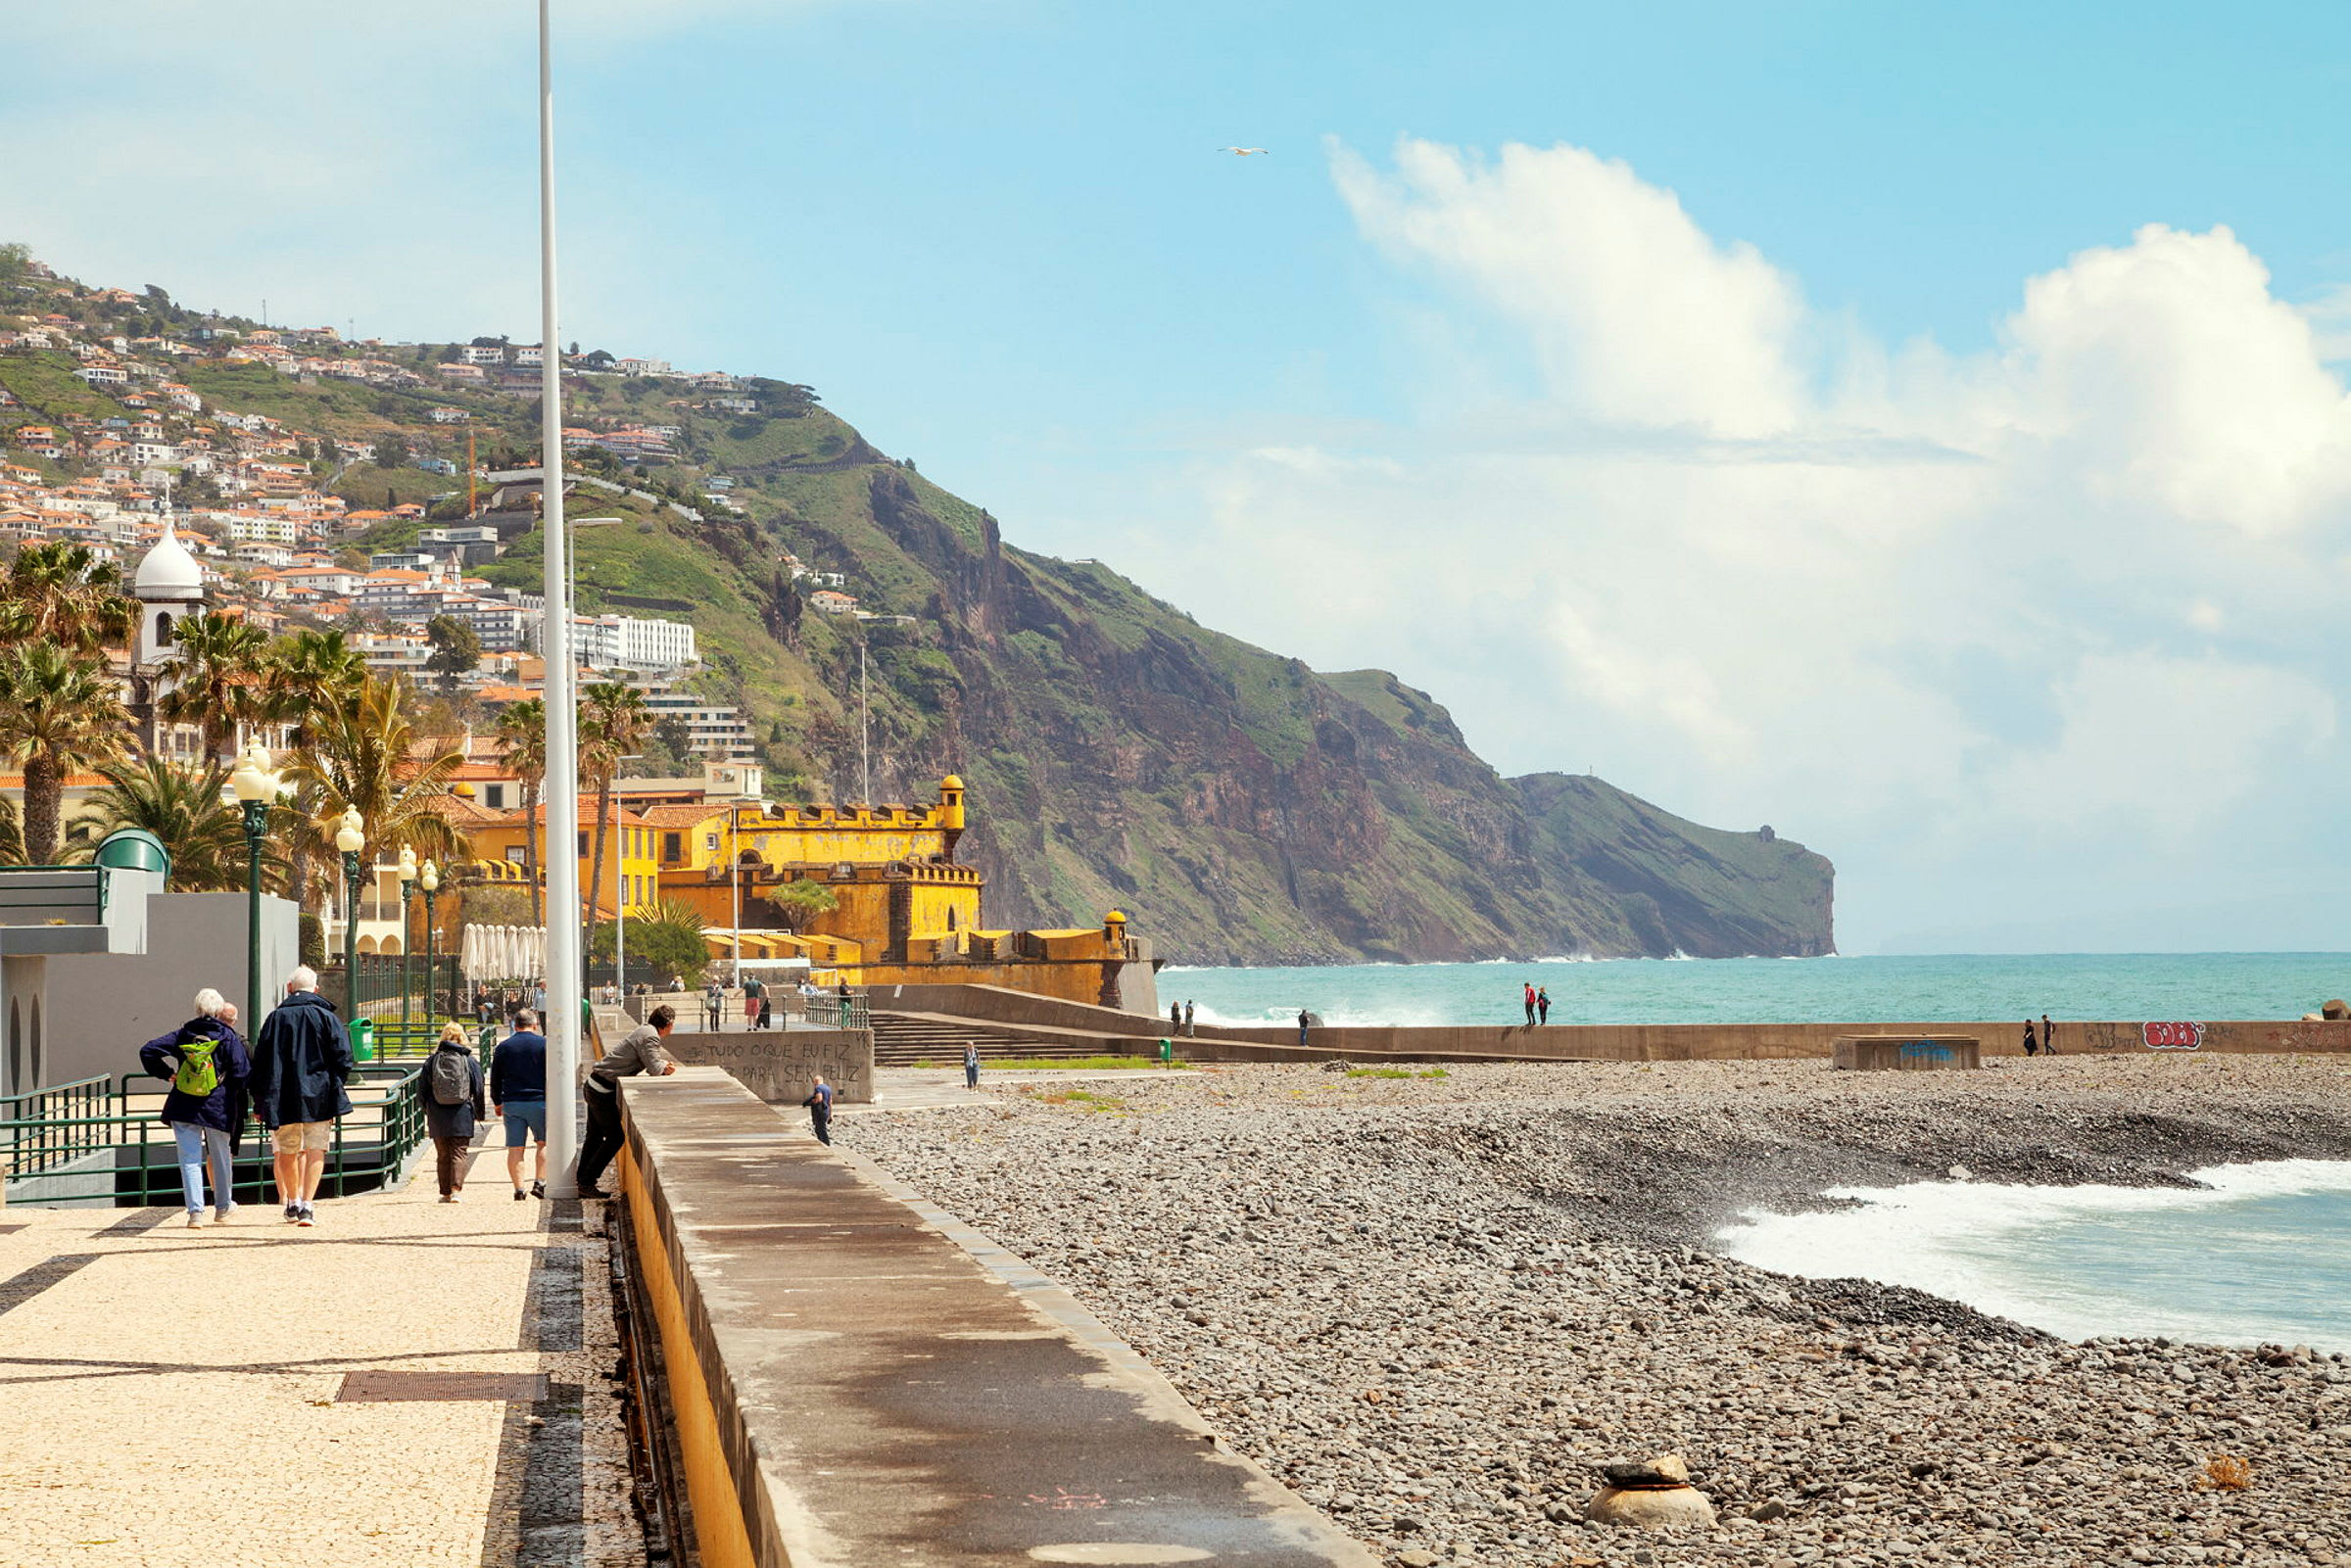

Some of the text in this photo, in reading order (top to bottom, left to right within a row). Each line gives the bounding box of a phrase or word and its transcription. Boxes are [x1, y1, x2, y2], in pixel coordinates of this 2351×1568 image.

[705, 1044, 744, 1058] TUDO
[802, 1043, 819, 1058] EU
[823, 1043, 851, 1061] FIZ
[743, 1065, 775, 1082] PARA
[784, 1064, 815, 1083] SER
[823, 1064, 859, 1082] FELIZ
